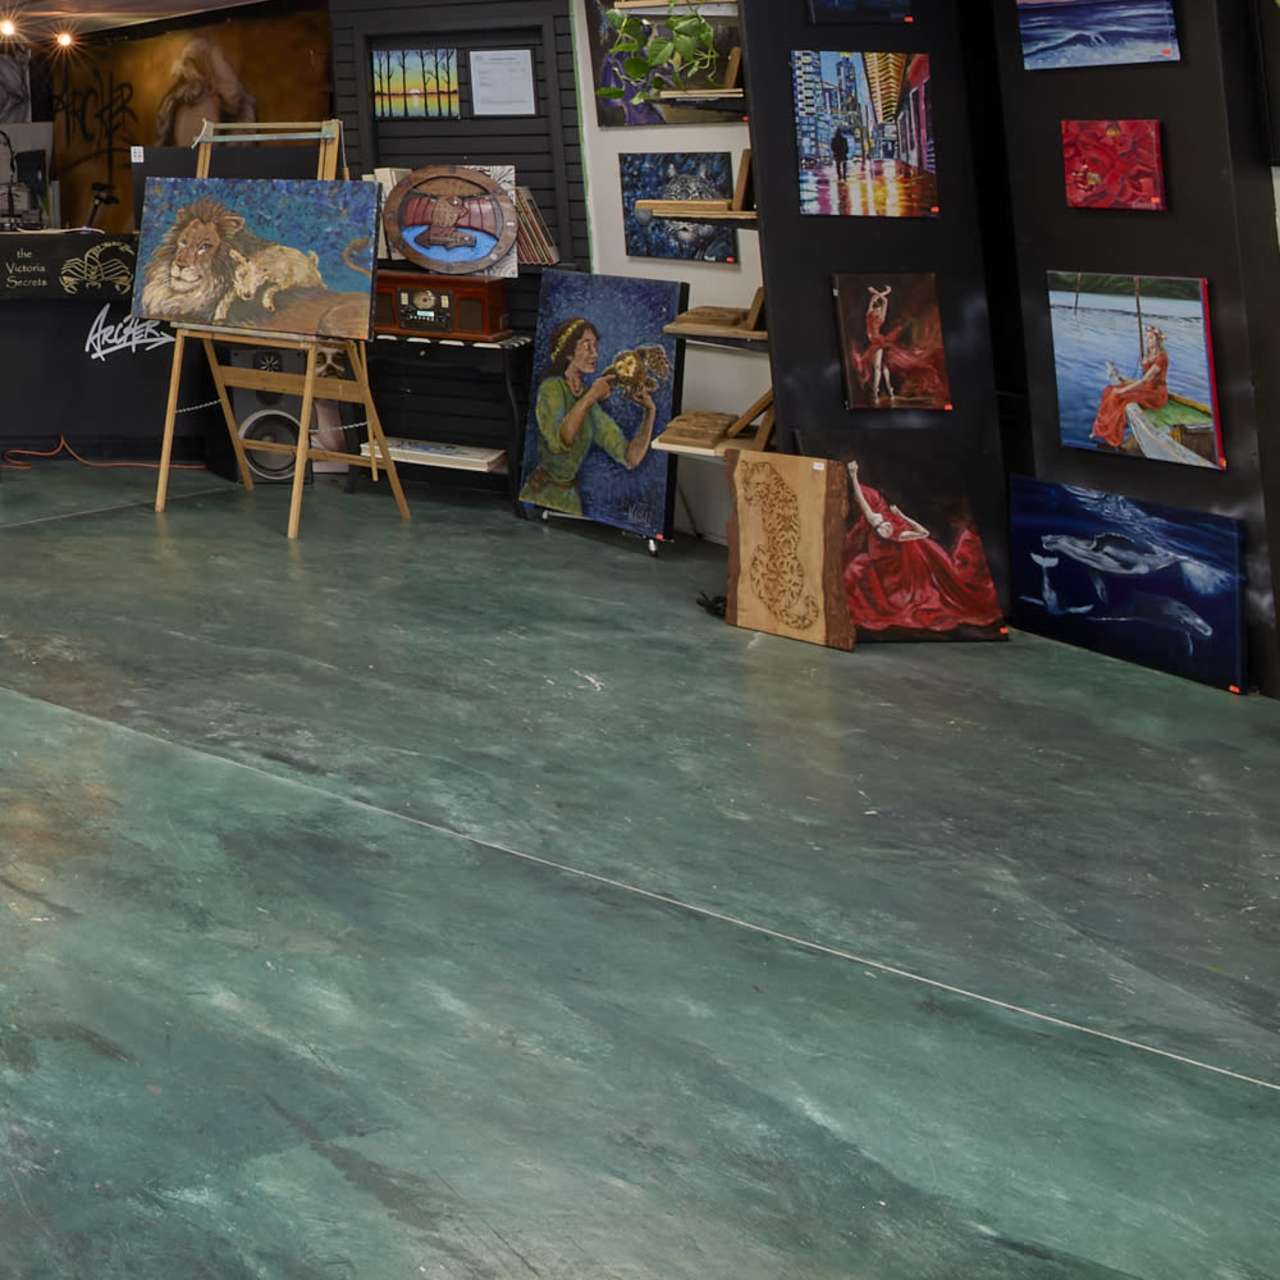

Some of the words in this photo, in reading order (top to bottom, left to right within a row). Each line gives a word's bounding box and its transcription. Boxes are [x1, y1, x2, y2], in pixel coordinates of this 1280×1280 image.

[16, 247, 33, 259] the
[5, 262, 47, 275] Victoria
[5, 275, 49, 289] Secrets
